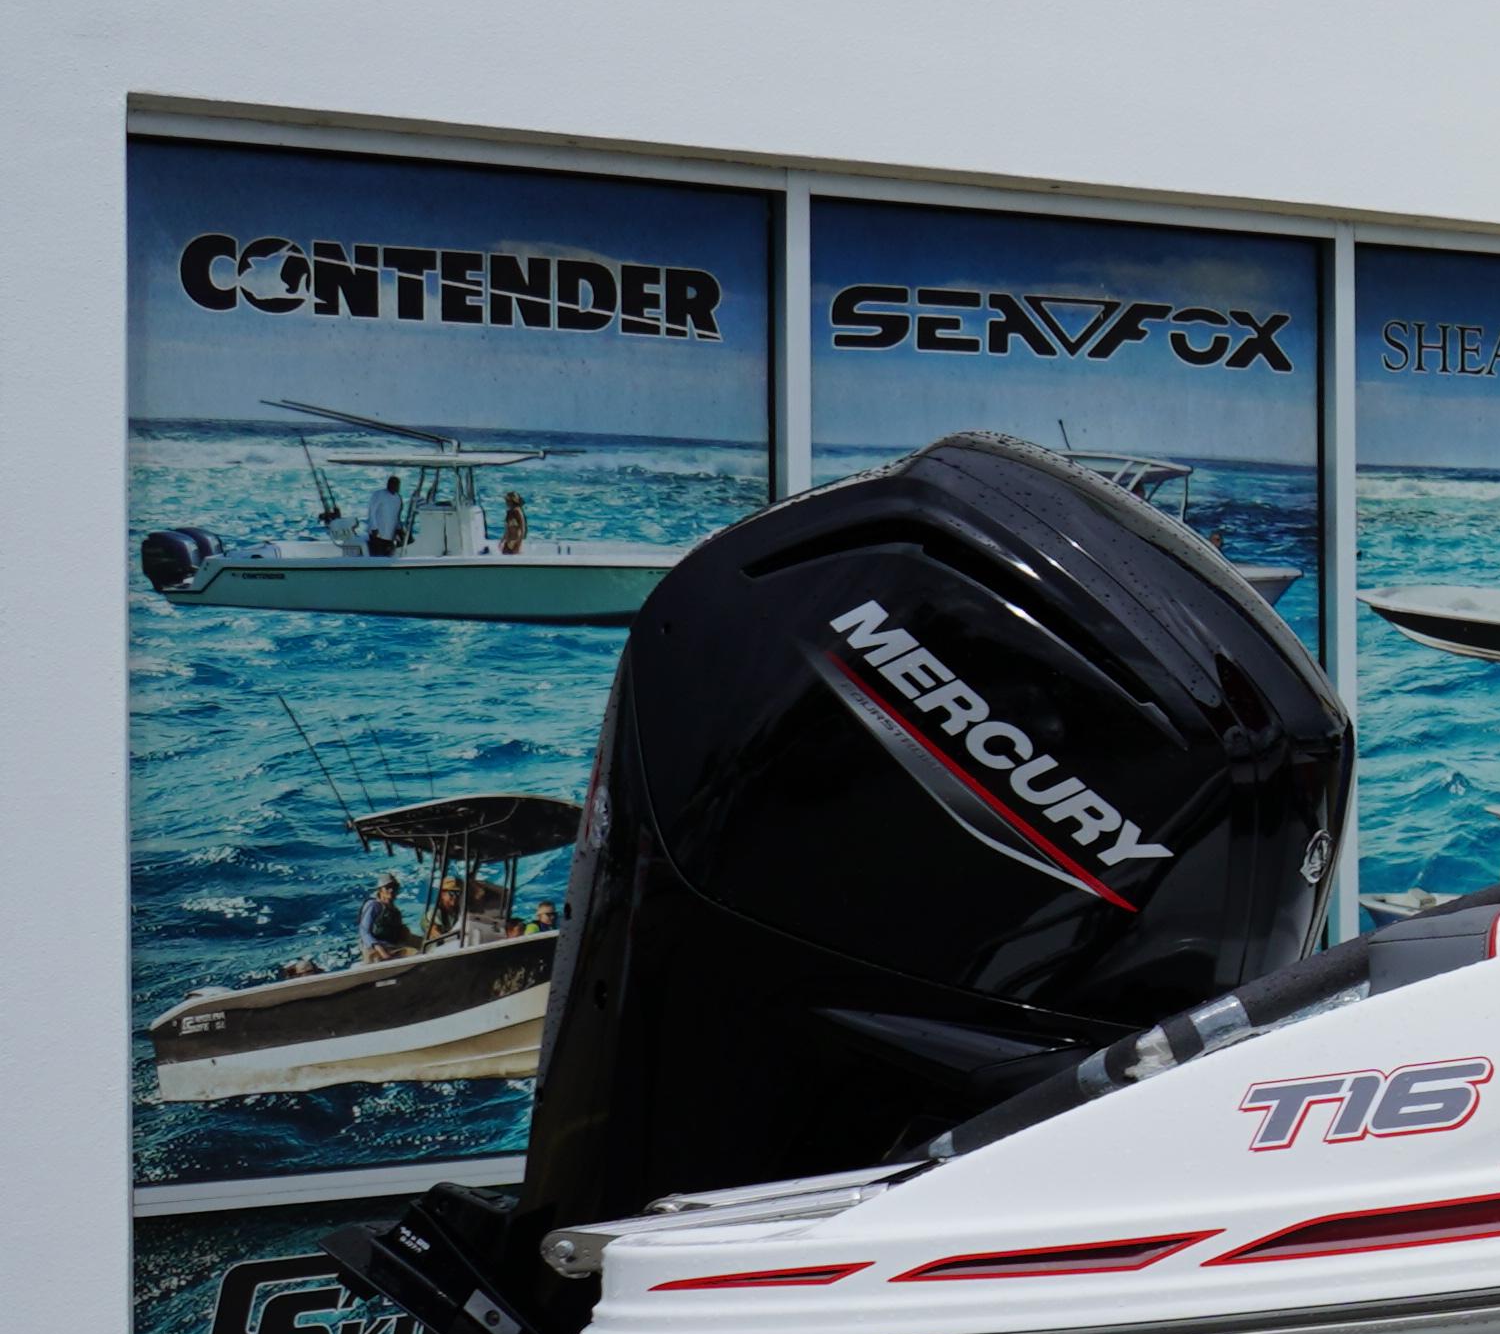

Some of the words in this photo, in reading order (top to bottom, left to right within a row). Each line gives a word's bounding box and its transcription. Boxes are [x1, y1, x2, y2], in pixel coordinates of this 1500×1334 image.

[180, 233, 724, 342] CONTENDER
[829, 599, 1174, 866] MERCURY
[1239, 1056, 1494, 1151] T16
